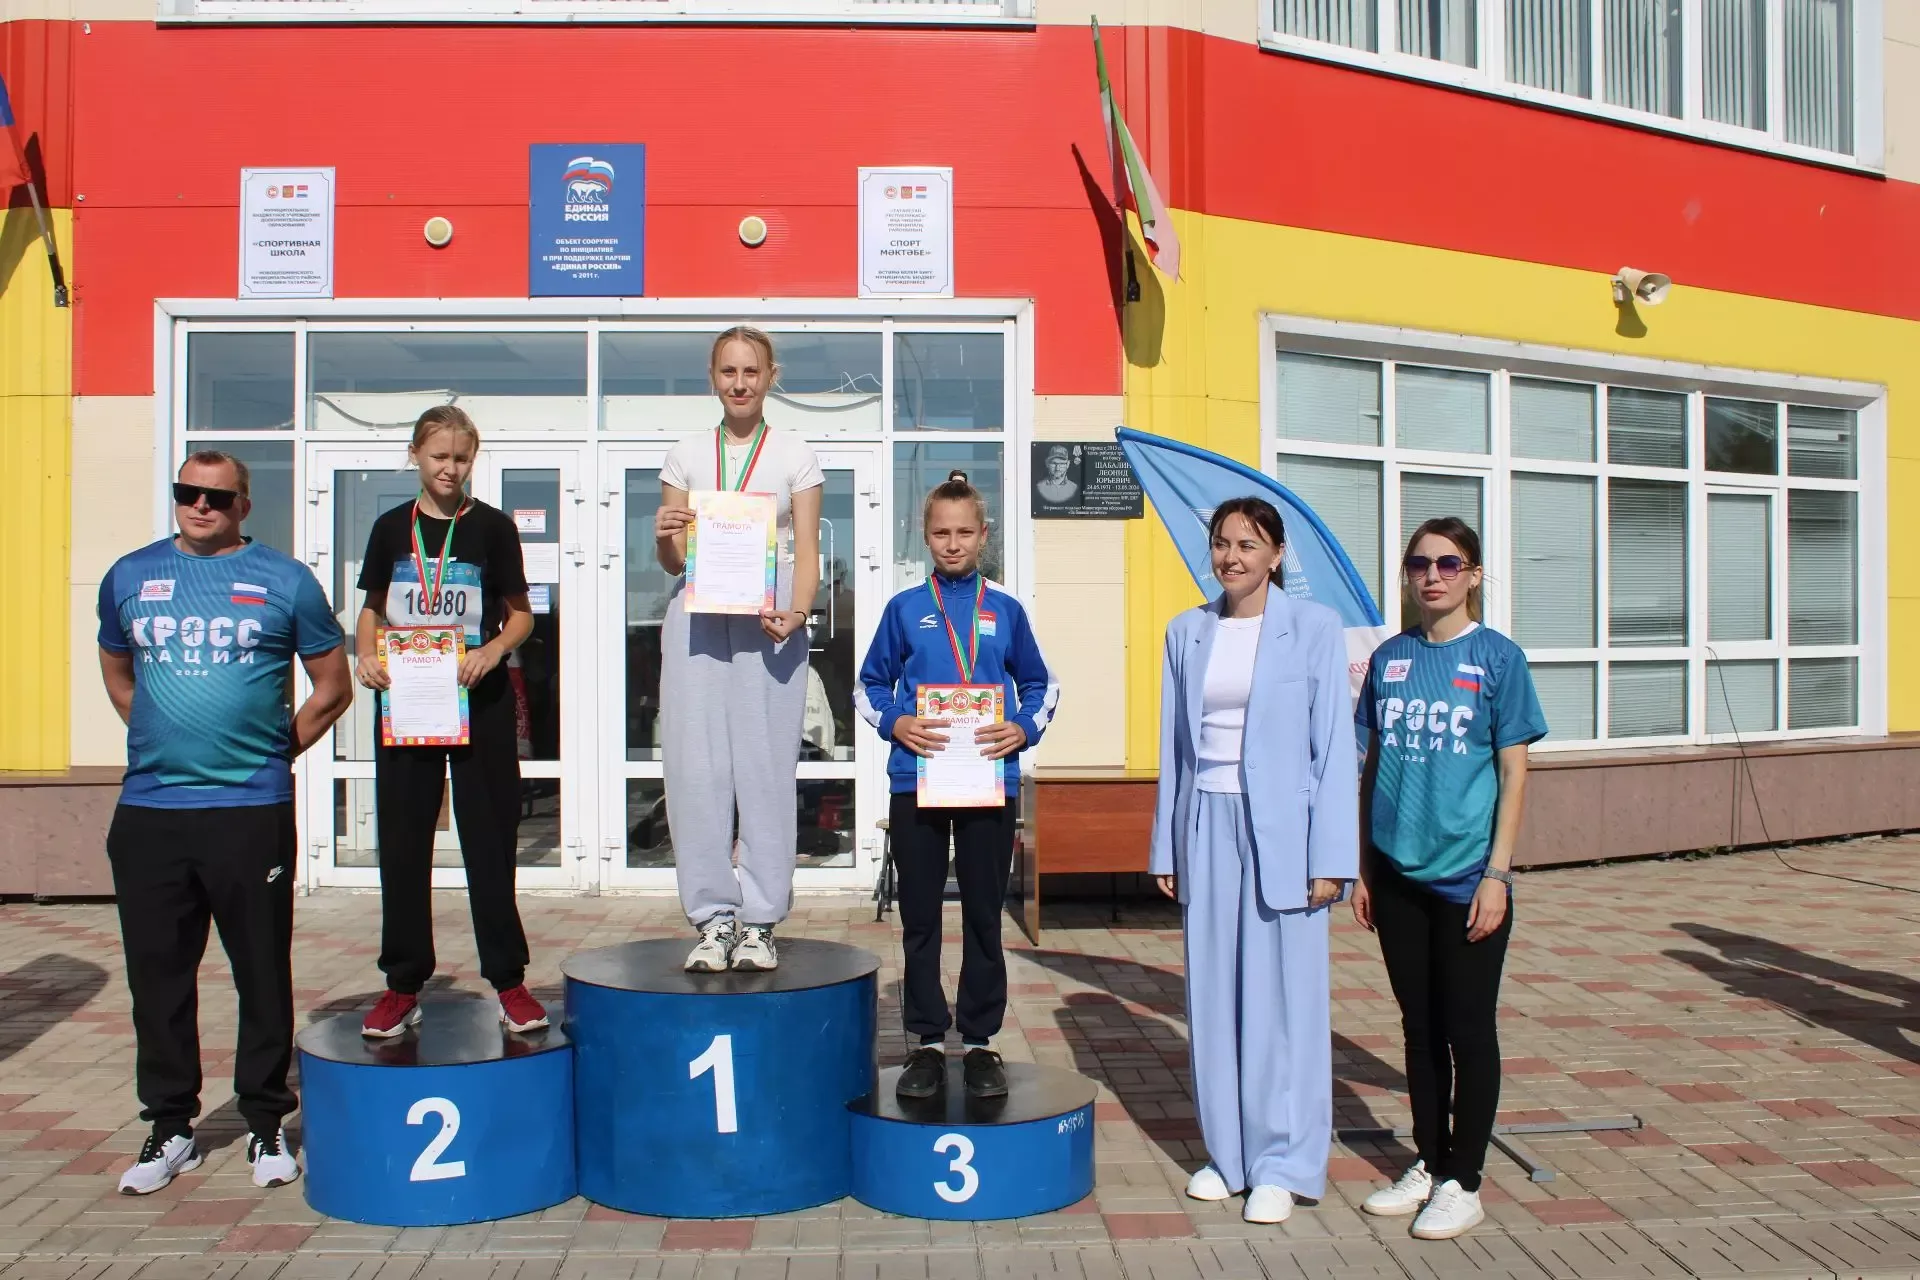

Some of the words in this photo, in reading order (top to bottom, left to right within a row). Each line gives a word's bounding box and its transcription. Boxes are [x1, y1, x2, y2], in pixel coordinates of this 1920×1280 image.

[565, 204, 609, 213] ЕДИНАЯ
[565, 213, 609, 221] РОССИЯ
[270, 249, 306, 257] ШКОЛА
[551, 263, 587, 271] «ЕДИНАЯ
[712, 522, 752, 531] ГРАМОТА
[404, 588, 467, 617] 16980
[132, 615, 263, 649] КРОСС
[143, 649, 255, 665] НАЦИИ
[402, 656, 442, 664] ГРАМОТА
[1383, 732, 1468, 755] АЦИИ
[688, 1034, 738, 1134] 1
[405, 1096, 467, 1182] 2
[932, 1132, 979, 1204] 3
